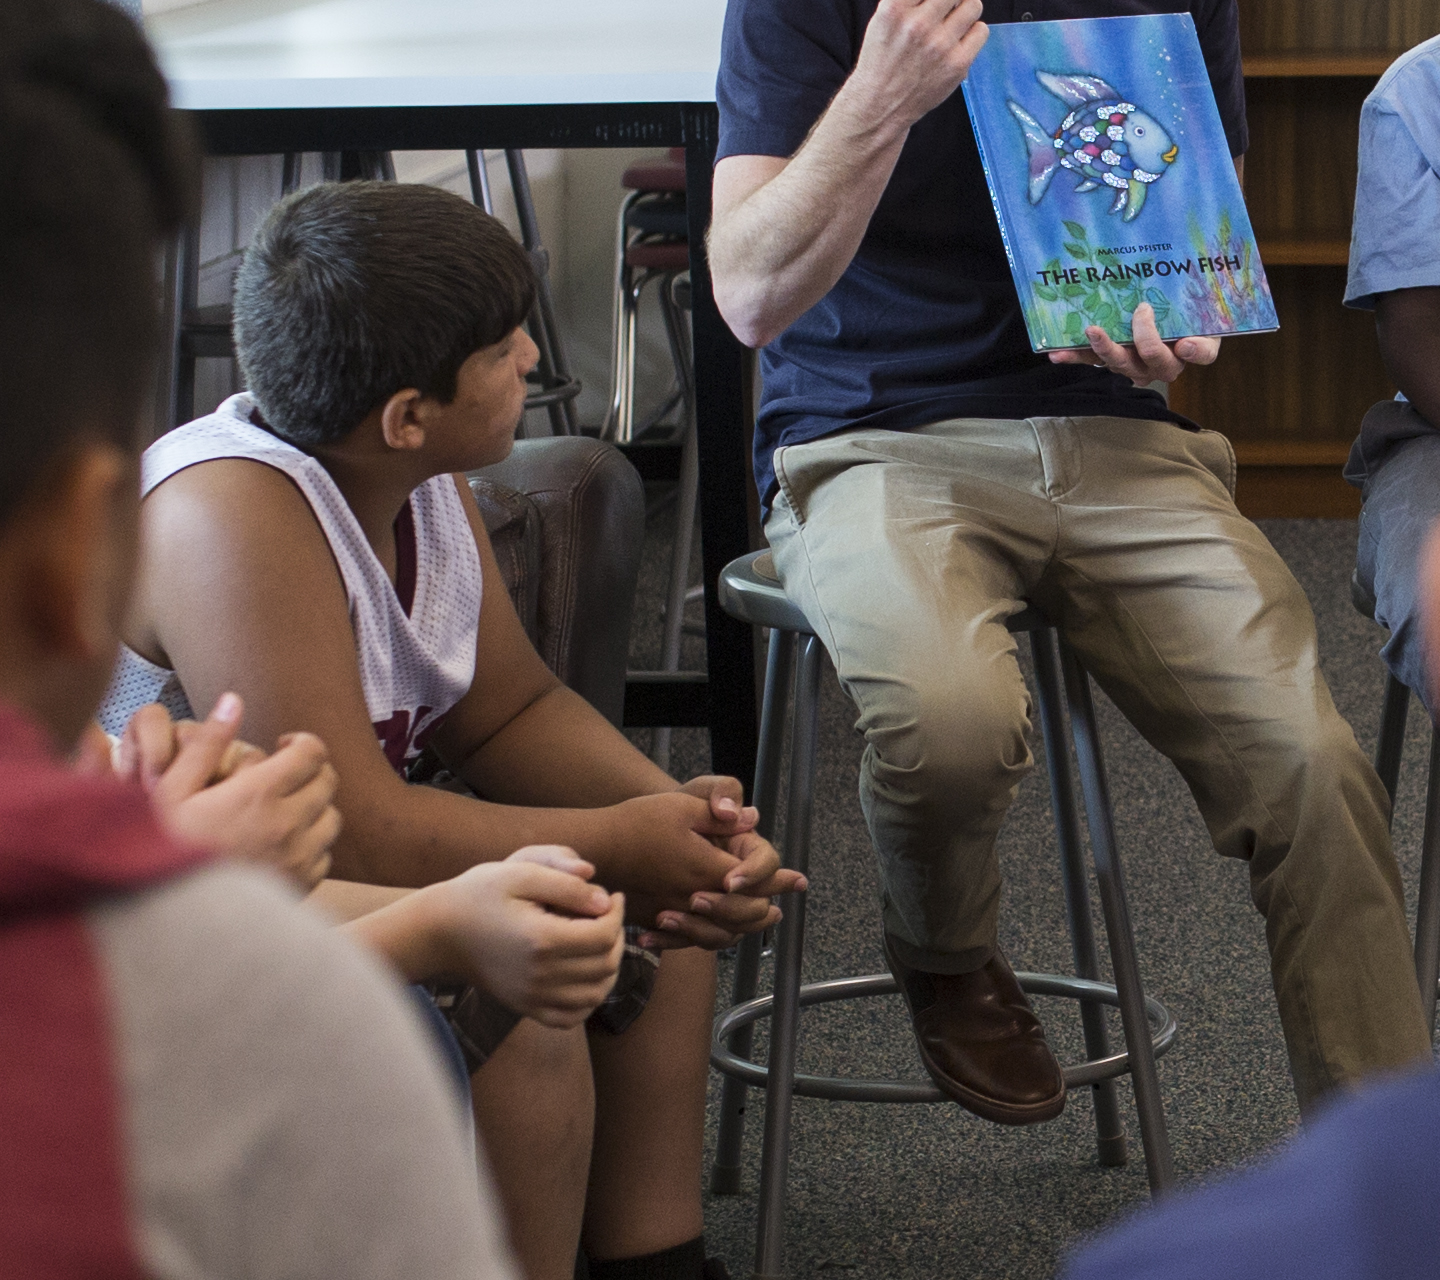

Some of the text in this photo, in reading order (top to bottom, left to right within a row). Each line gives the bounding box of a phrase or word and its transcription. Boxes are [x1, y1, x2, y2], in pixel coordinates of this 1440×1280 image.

[1098, 243, 1173, 256] MARCUS PFISTER
[1036, 255, 1242, 287] THE RAINBOW FISH
